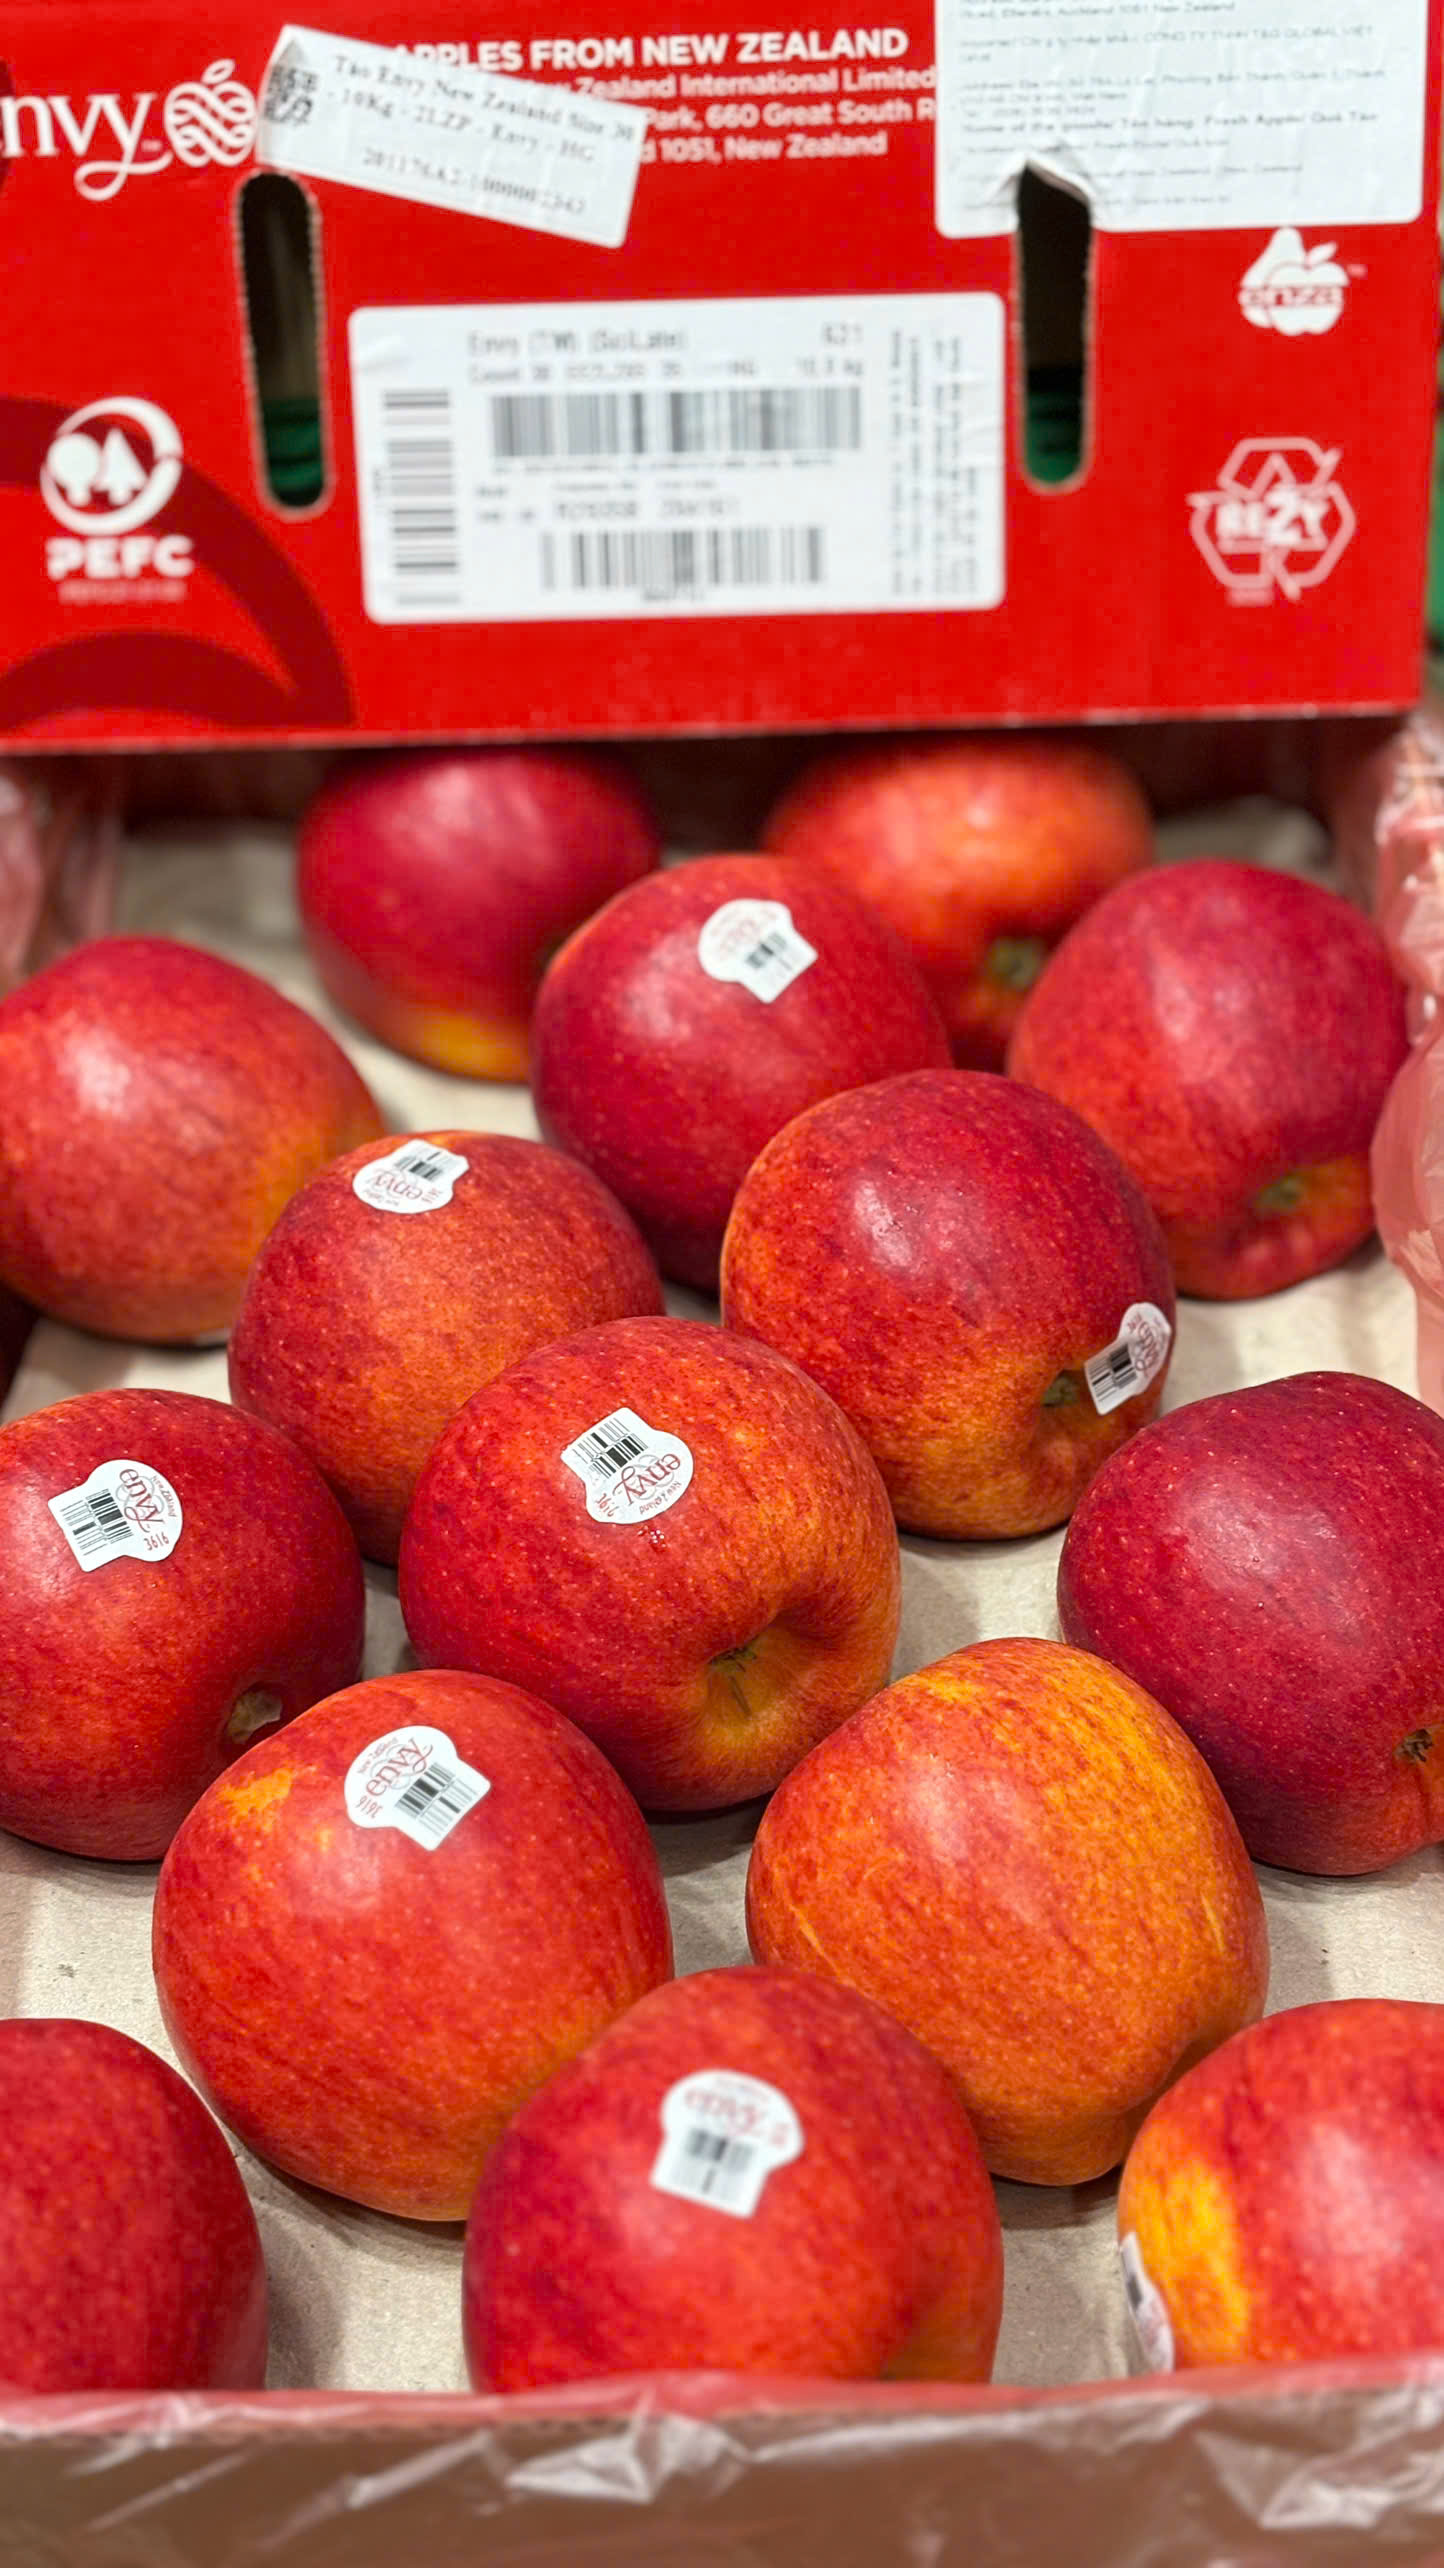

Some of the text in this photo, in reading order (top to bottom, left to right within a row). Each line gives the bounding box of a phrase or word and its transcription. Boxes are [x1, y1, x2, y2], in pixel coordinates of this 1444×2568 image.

[529, 37, 634, 69] FROM
[640, 33, 729, 66] NEW
[735, 27, 909, 63] ZEALAND
[575, 73, 676, 100] Zealand
[679, 68, 839, 97] International
[842, 64, 936, 93] Limited
[705, 103, 760, 129] 660
[762, 101, 834, 128] Great
[837, 98, 913, 125] South
[0, 91, 173, 202] nvy
[724, 134, 784, 161] New
[785, 129, 889, 160] Zealand
[46, 534, 194, 580] PEFC
[119, 1468, 165, 1534] envy
[612, 1452, 682, 1507] envy
[143, 1531, 170, 1552] 3616
[366, 1736, 434, 1797] envy
